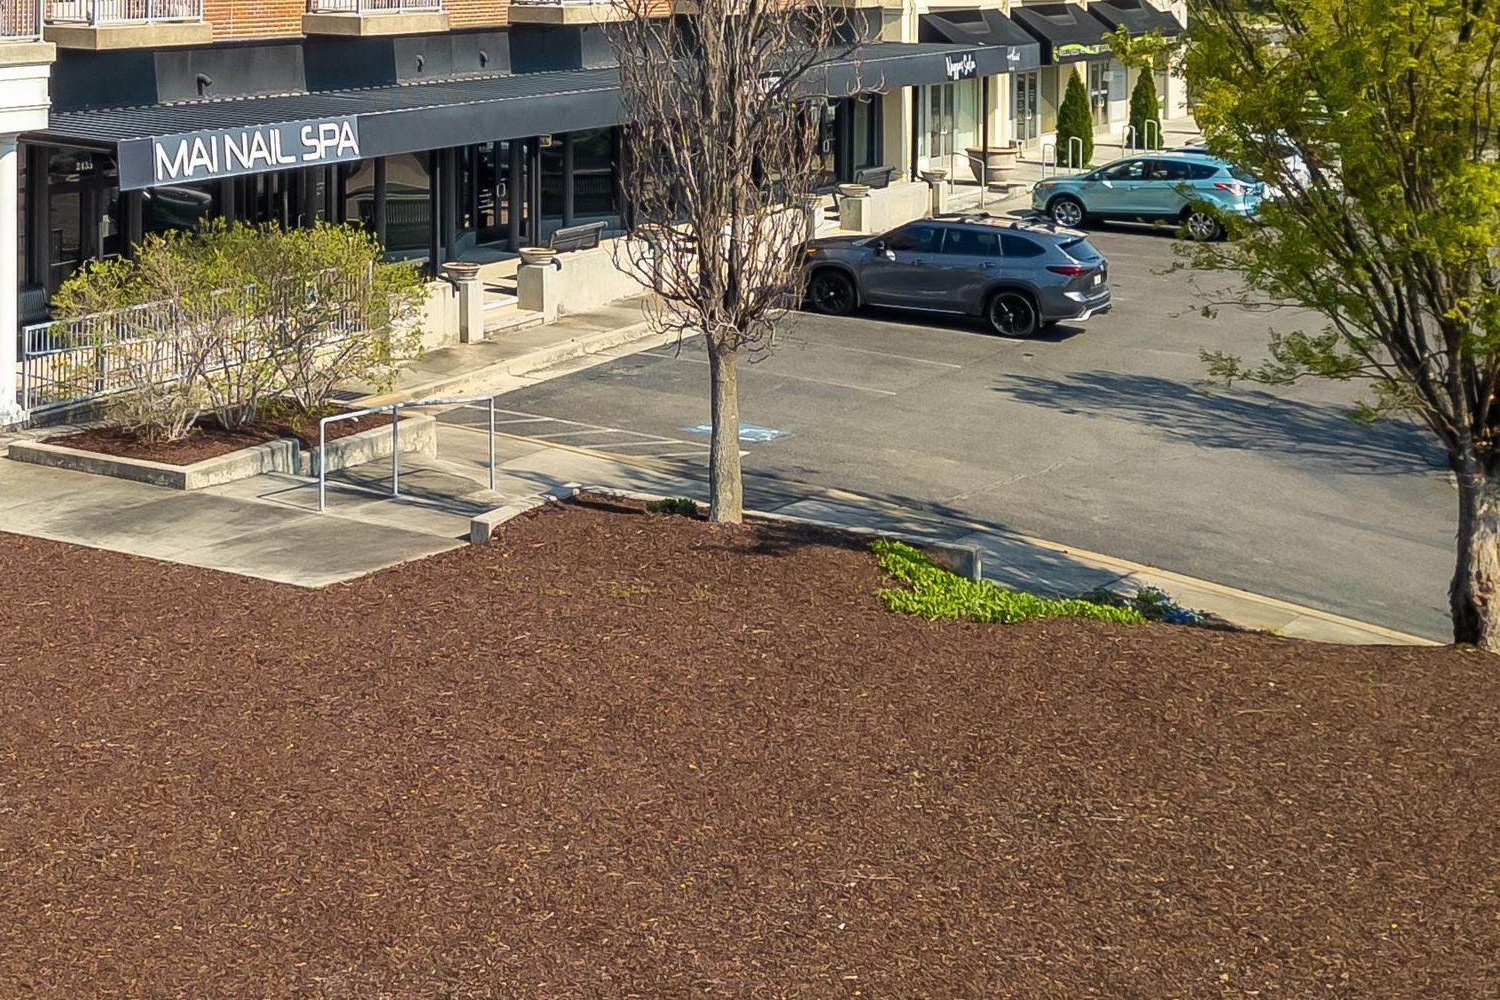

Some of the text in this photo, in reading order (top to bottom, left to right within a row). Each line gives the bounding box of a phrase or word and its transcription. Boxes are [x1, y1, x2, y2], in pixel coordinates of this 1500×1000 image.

[155, 121, 360, 181] MAI NAIL SPA
